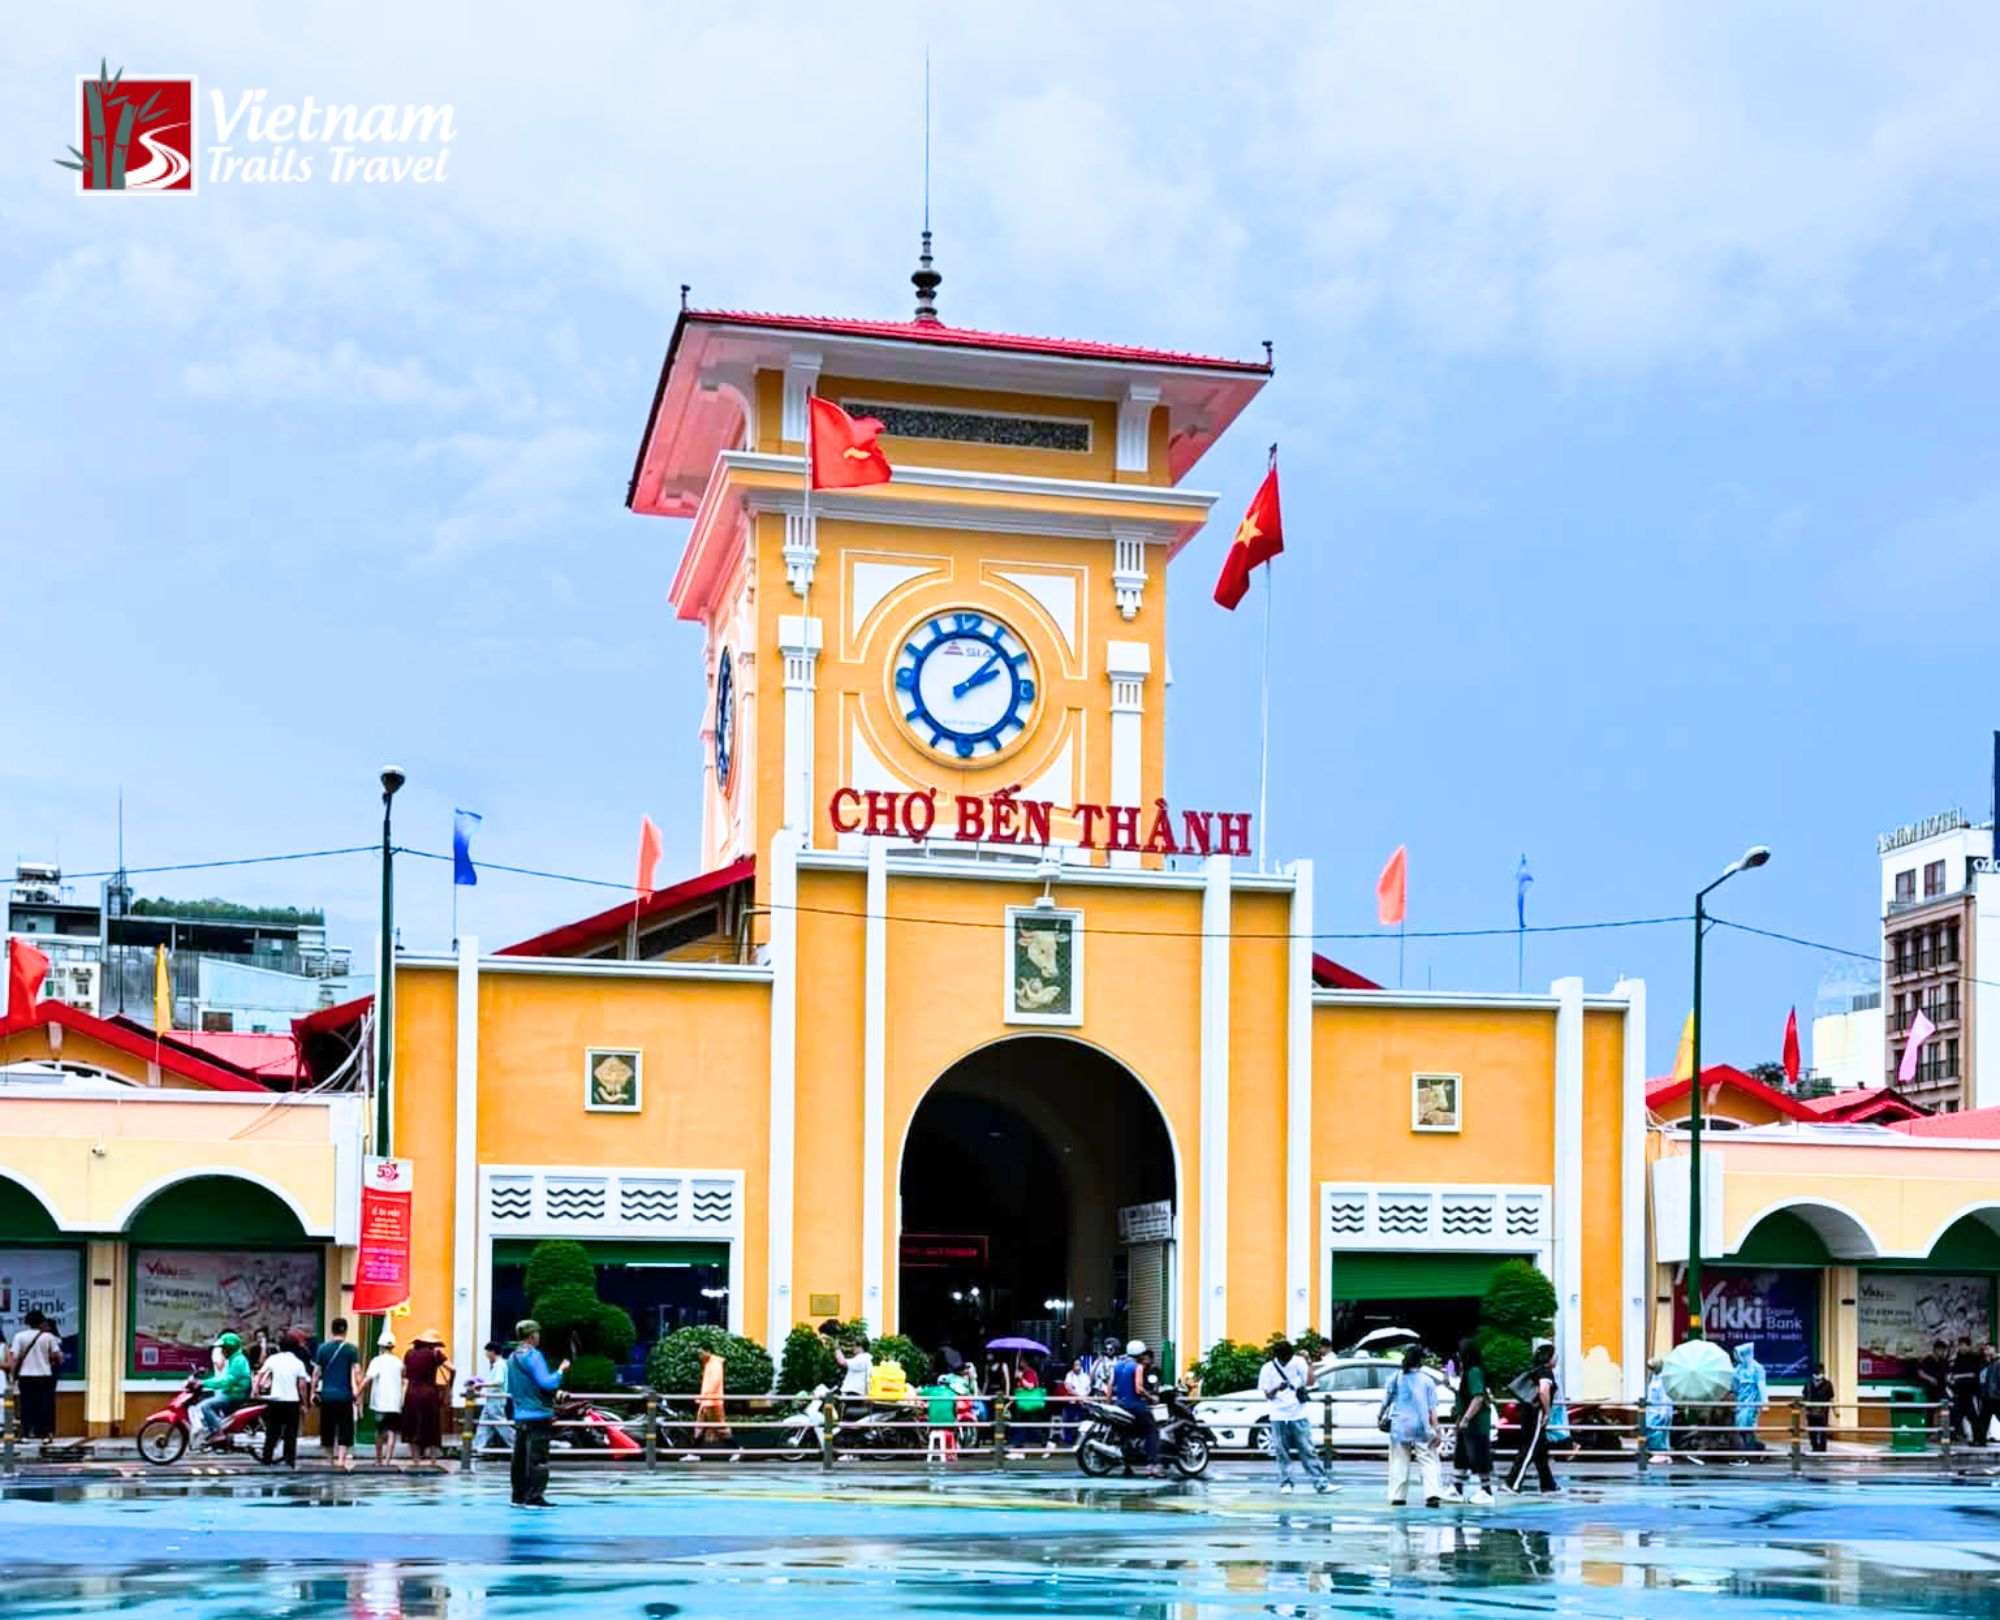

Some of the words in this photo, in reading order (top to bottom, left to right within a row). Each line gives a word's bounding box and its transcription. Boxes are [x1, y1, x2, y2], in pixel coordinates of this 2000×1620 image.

[954, 613, 983, 634] 12
[829, 787, 937, 843] CHỢ
[955, 784, 1054, 846] BẾN
[1072, 797, 1252, 856] THÀNH
[18, 1288, 55, 1298] Digital
[18, 1299, 66, 1313] Bank
[1766, 1316, 1802, 1329] Bank
